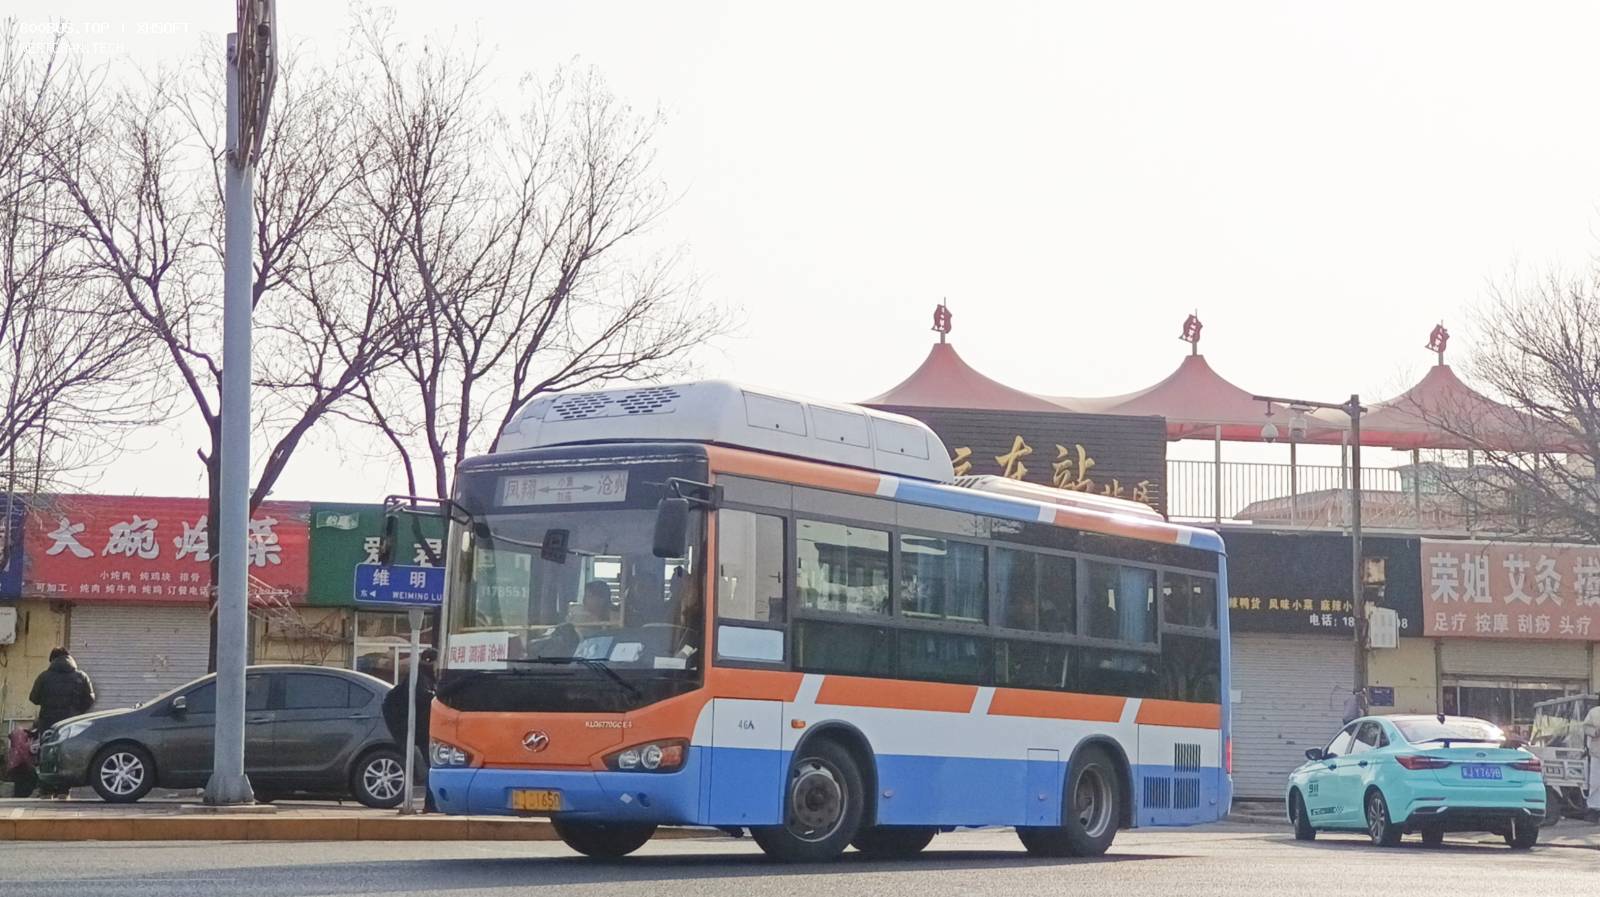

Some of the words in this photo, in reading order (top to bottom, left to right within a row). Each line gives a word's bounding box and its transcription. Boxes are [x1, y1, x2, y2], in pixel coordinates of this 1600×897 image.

[1429, 551, 1493, 604] 荣姐
[1502, 553, 1562, 607] 艾灸
[392, 590, 429, 601] WEIMING
[1268, 598, 1314, 612] 风味小菜
[1433, 612, 1467, 633] 足疗
[1475, 613, 1509, 633] 按摩
[1518, 614, 1551, 634] 刮痧
[1559, 615, 1592, 635] 头疗
